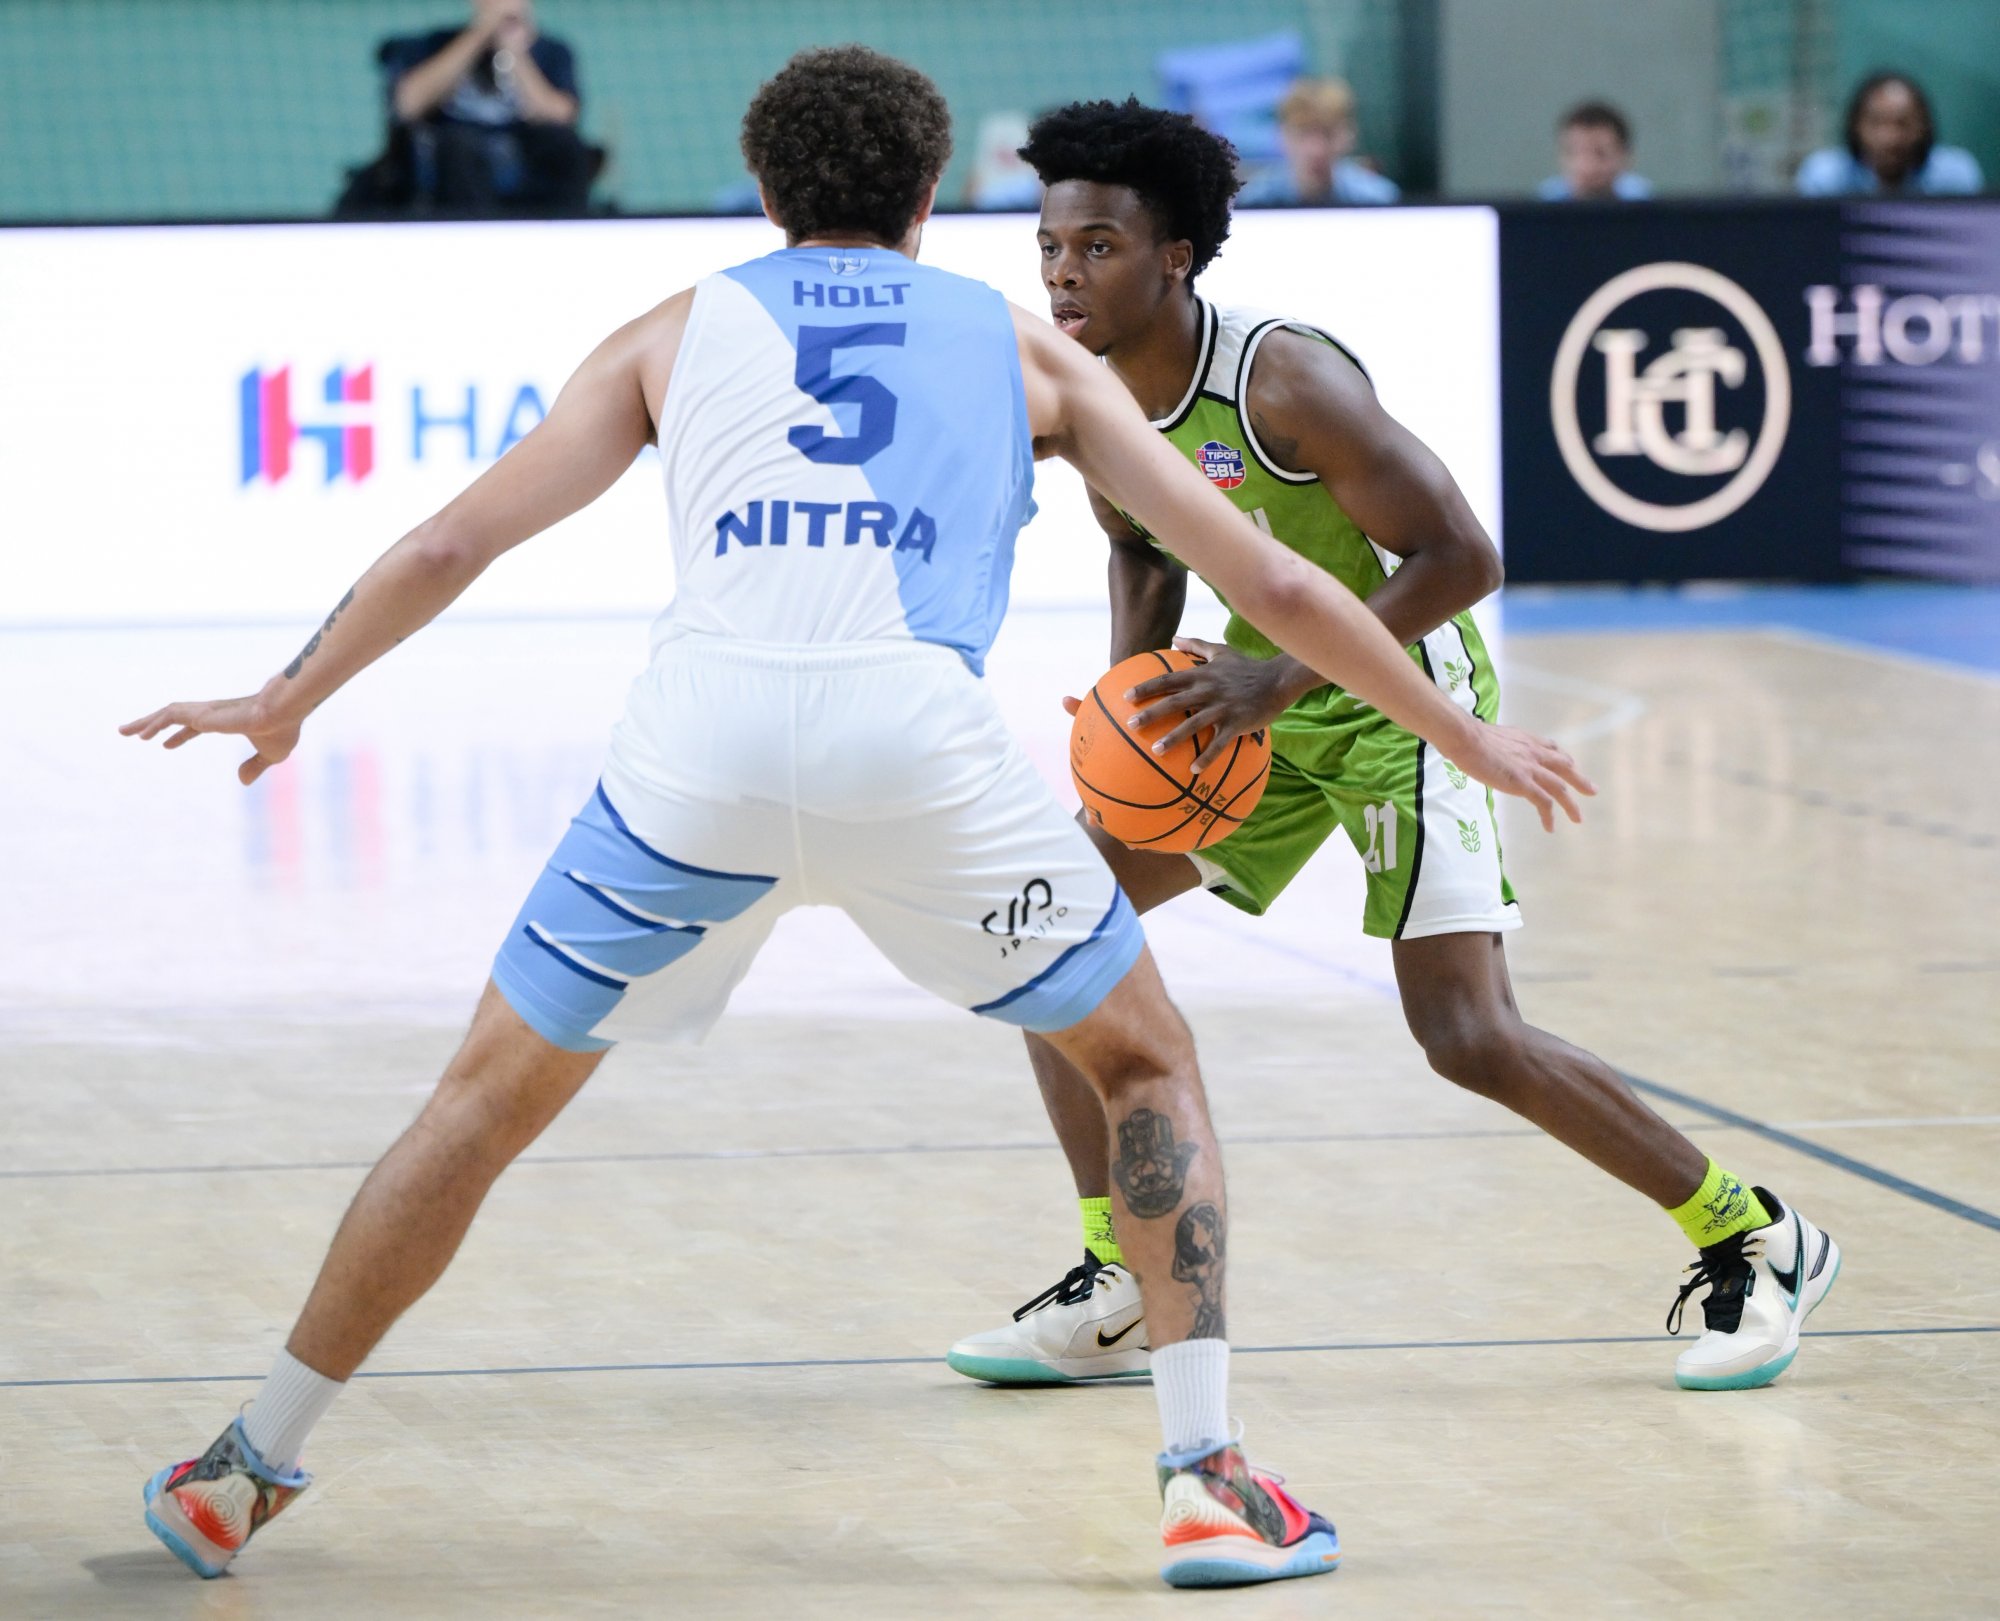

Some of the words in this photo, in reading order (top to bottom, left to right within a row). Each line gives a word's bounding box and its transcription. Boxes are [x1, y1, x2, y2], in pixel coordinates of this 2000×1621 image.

[793, 280, 911, 308] HOLT
[1804, 283, 2000, 366] HOT
[411, 384, 549, 460] HA
[787, 322, 907, 466] 5
[1204, 462, 1244, 478] SBL
[1206, 451, 1239, 460] TIPOS
[715, 500, 937, 565] NITRA
[1362, 800, 1398, 874] 21
